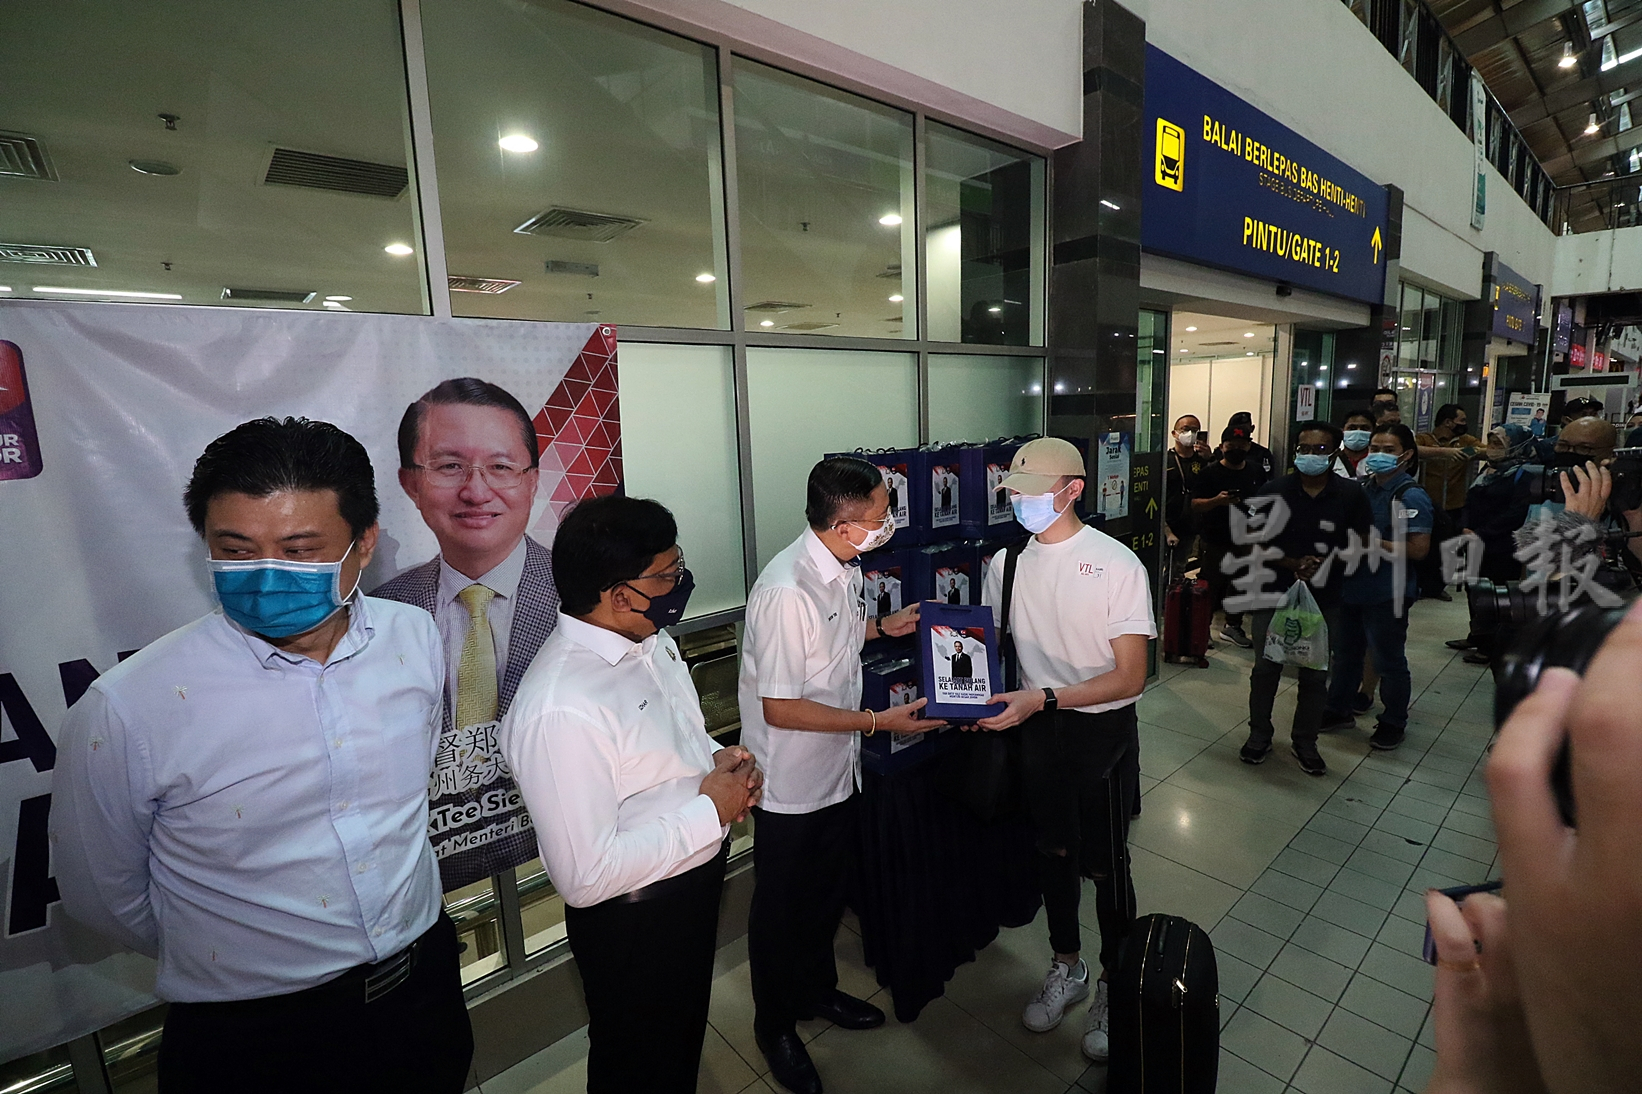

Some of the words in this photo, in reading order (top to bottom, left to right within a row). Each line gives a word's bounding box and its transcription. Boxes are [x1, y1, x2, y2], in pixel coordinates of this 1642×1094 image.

[1203, 115, 1242, 156] BALAI
[1245, 137, 1298, 183] BERLEPAS
[1300, 167, 1319, 193] BAS
[1320, 178, 1366, 218] HENTI-HENTI
[1243, 216, 1322, 268] PINTU/GATE
[1325, 247, 1340, 273] 1-2
[1300, 387, 1312, 407] VTL
[1142, 532, 1154, 548] 1-2
[1079, 562, 1094, 574] VTL
[938, 682, 948, 690] KE
[950, 683, 973, 691] TANAH
[428, 756, 510, 796] 州务大
[437, 805, 478, 826] Tee
[453, 821, 515, 850] Menteri
